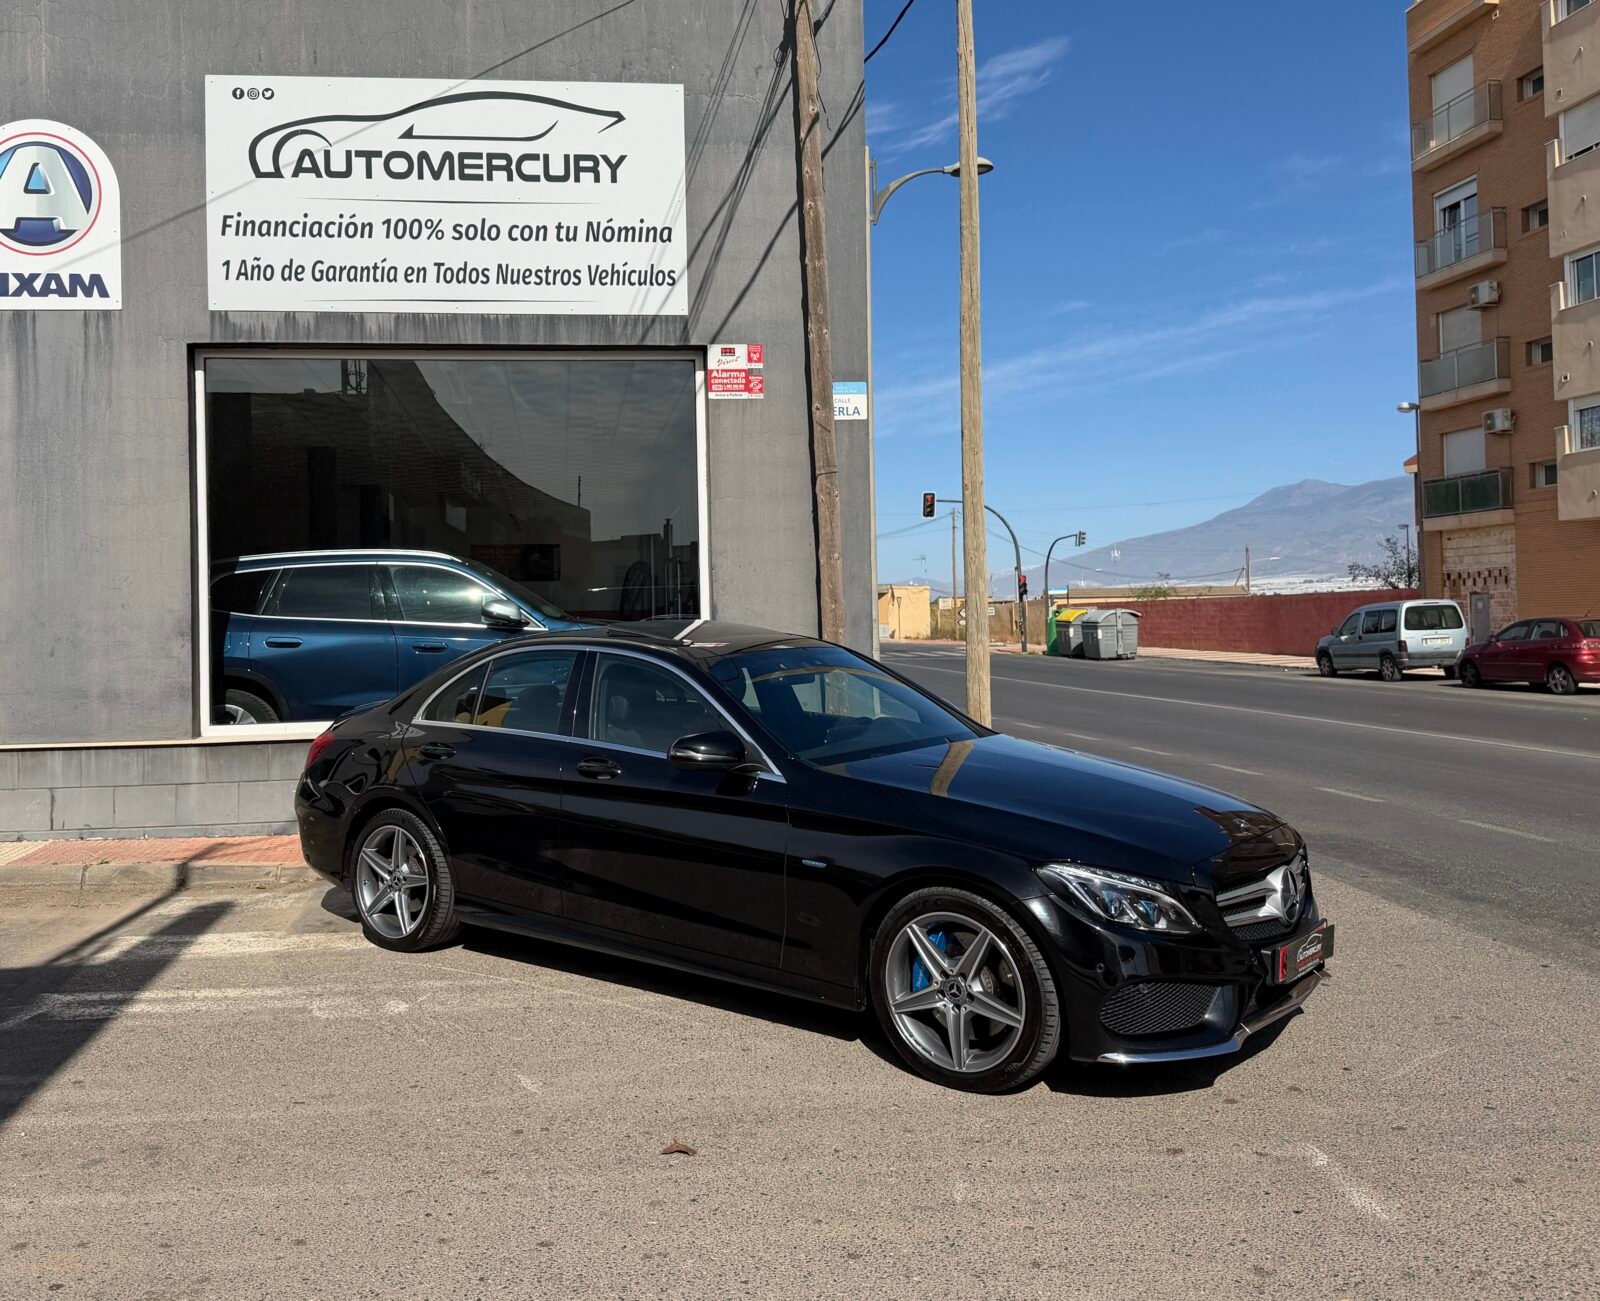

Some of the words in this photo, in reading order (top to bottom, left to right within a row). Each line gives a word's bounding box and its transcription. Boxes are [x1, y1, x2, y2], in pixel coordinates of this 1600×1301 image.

[290, 148, 628, 184] AUTOMERCURY
[221, 212, 374, 239] Financiación
[381, 218, 445, 241] 100%
[451, 217, 501, 242] solo
[507, 224, 548, 243] con
[555, 221, 578, 243] tu
[585, 218, 673, 244] Nómina
[222, 259, 231, 281] 1
[235, 256, 275, 282] Año
[280, 258, 306, 282] de
[311, 257, 398, 283] Garantía
[403, 266, 427, 284] en
[433, 261, 490, 285] Todos
[495, 263, 582, 286] Nuestros
[587, 261, 677, 287] Vehículos
[711, 369, 745, 378] Alarma
